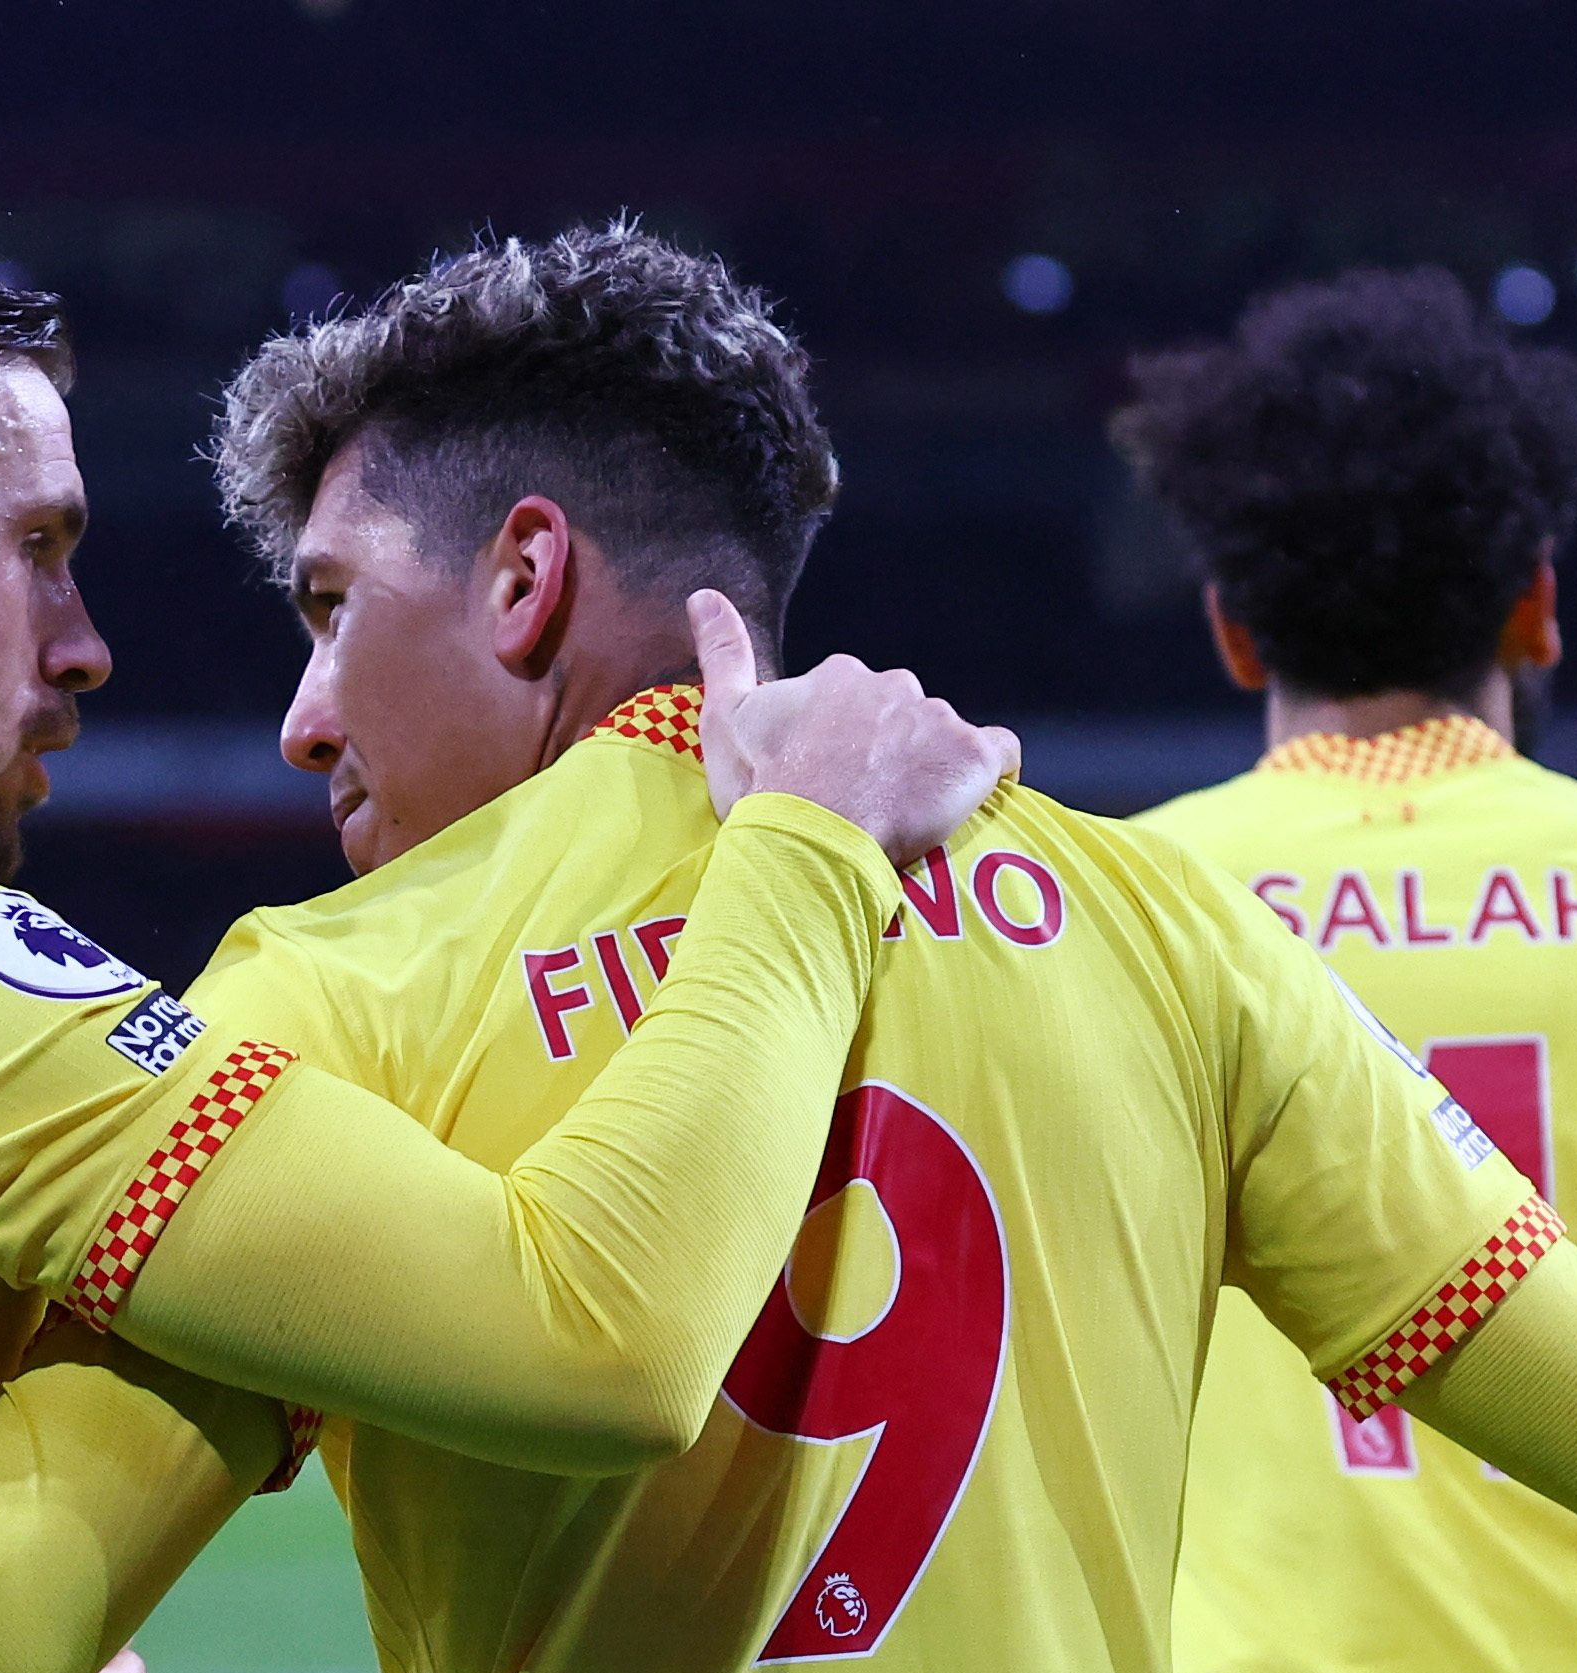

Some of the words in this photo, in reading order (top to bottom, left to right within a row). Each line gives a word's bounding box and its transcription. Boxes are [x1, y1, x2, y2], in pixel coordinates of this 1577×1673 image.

[106, 1014, 163, 1062] No
[520, 840, 1067, 1062] FINO
[721, 1079, 1012, 1669] 9
